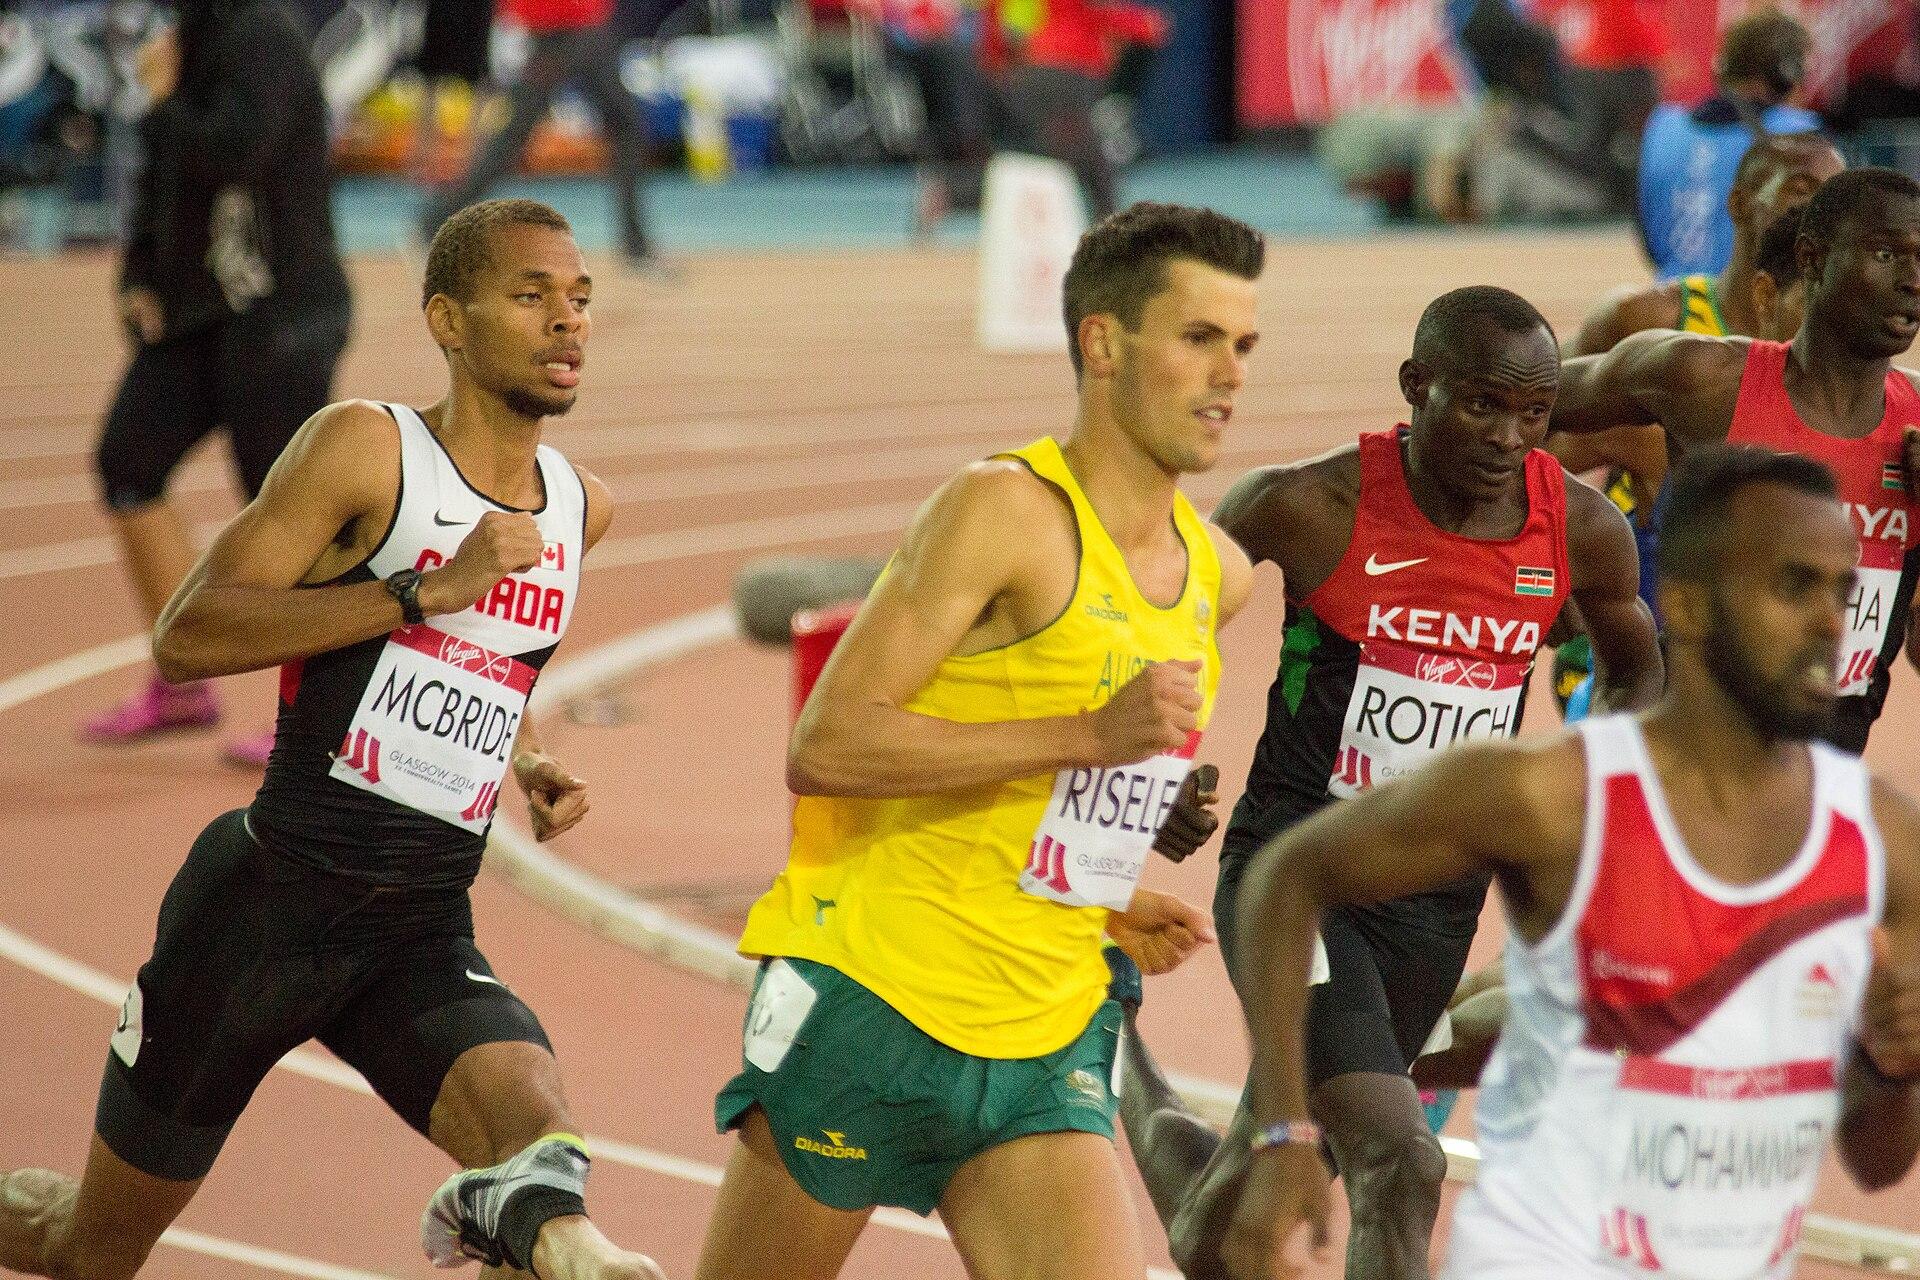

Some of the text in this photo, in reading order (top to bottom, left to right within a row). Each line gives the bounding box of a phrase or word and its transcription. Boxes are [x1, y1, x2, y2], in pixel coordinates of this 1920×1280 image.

[1084, 605, 1128, 623] DIADORA
[1366, 604, 1540, 654] KENYA
[371, 664, 518, 762] MCBRIDE
[1356, 685, 1511, 749] ROTICH
[389, 750, 476, 792] GLASGOW 2014
[795, 1137, 866, 1160] DIADORA
